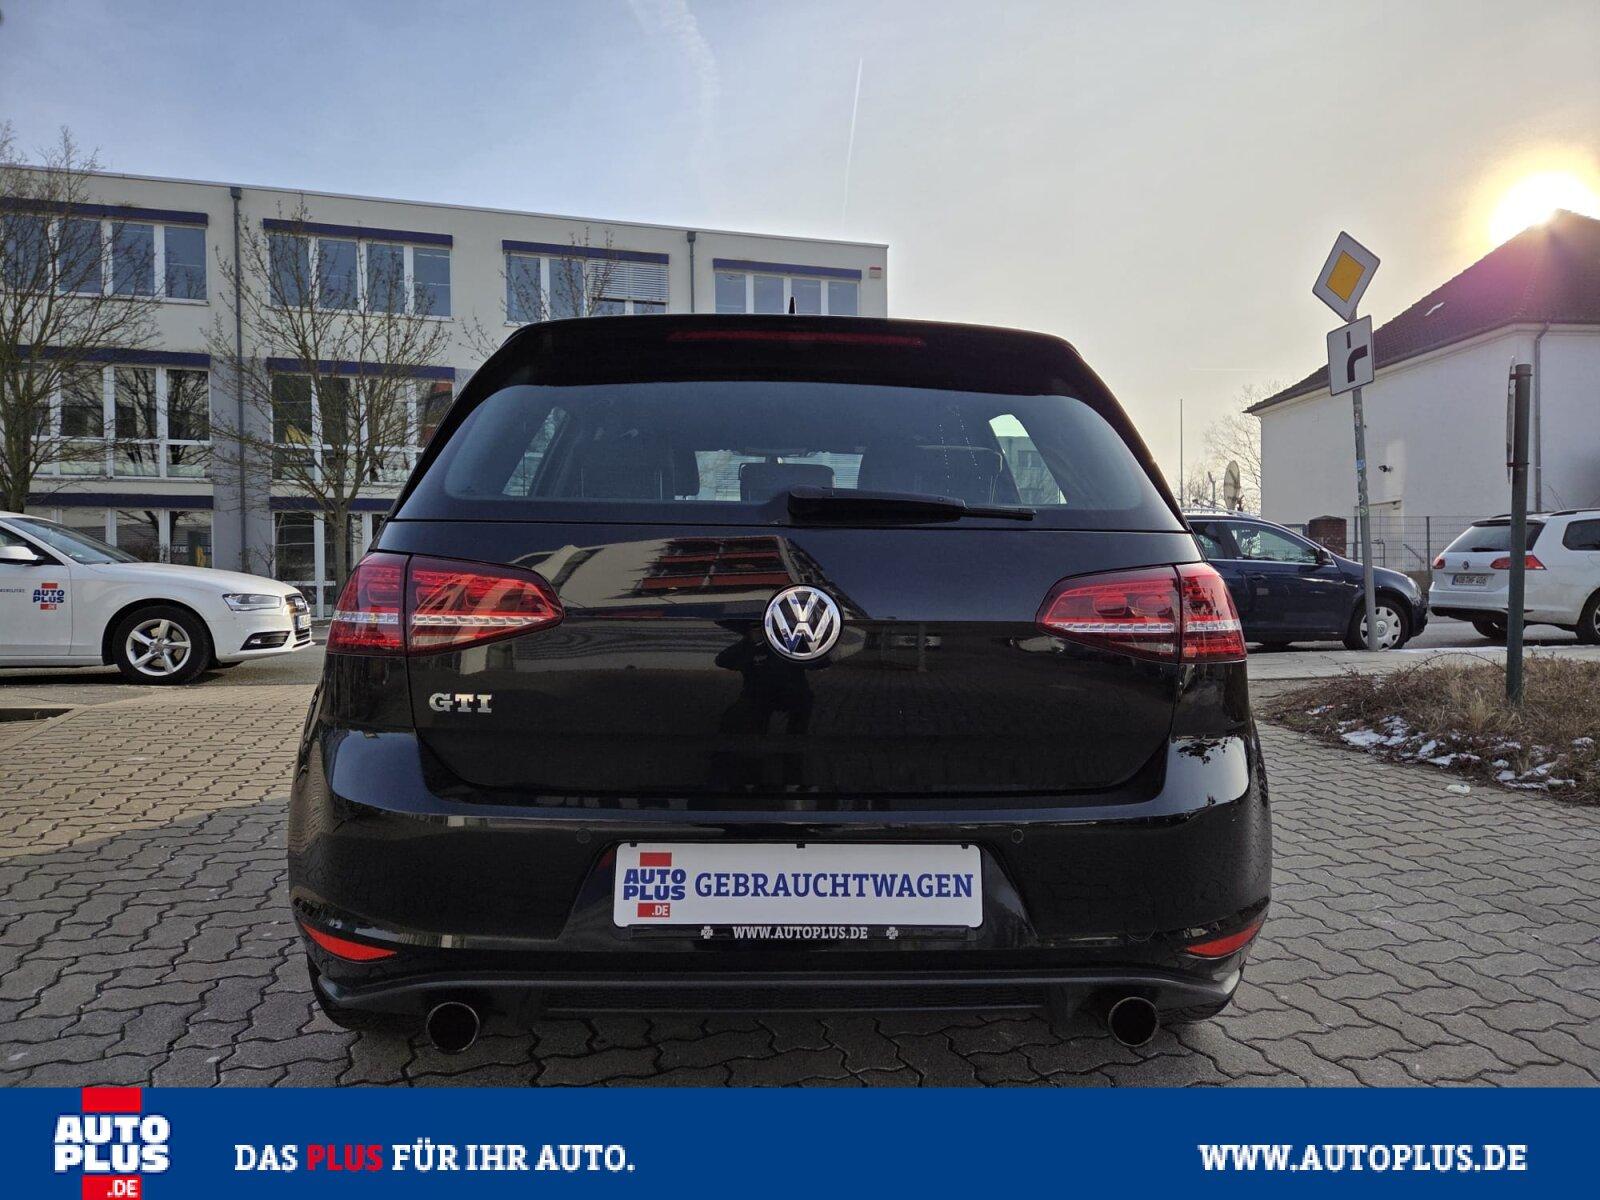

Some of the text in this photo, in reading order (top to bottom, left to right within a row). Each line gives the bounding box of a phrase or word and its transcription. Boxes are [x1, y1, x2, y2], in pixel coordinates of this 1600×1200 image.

[429, 693, 492, 713] GTI
[624, 869, 686, 884] AUTO
[695, 872, 974, 898] GEBRAUCHTWAGEN
[624, 885, 686, 901] PLUS
[652, 905, 669, 916] .DE
[733, 926, 868, 939] WWW.AUTOPLUS.DE
